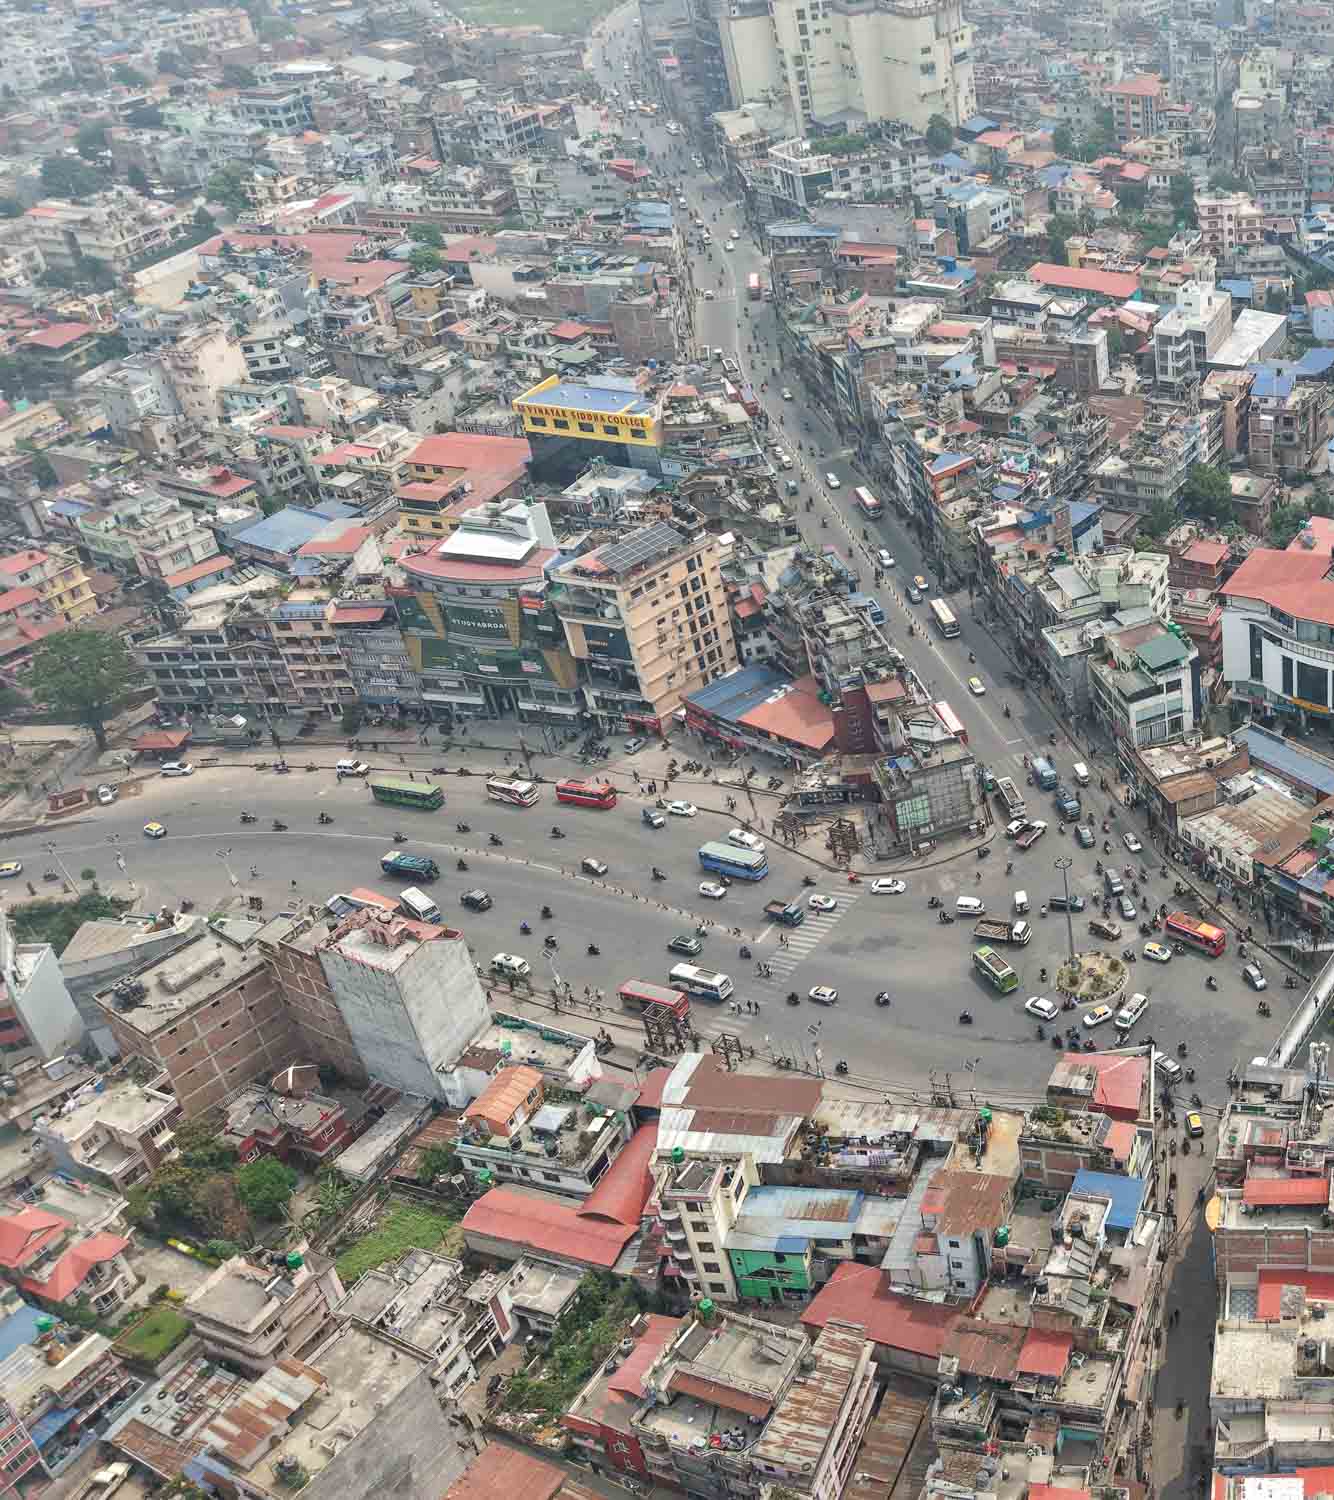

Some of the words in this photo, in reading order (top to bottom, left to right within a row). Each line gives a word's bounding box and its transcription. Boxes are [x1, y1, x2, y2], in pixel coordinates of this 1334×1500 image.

[527, 406, 568, 418] VINAYAK
[571, 411, 605, 423] SIDDHA
[607, 415, 645, 428] COLLEGE
